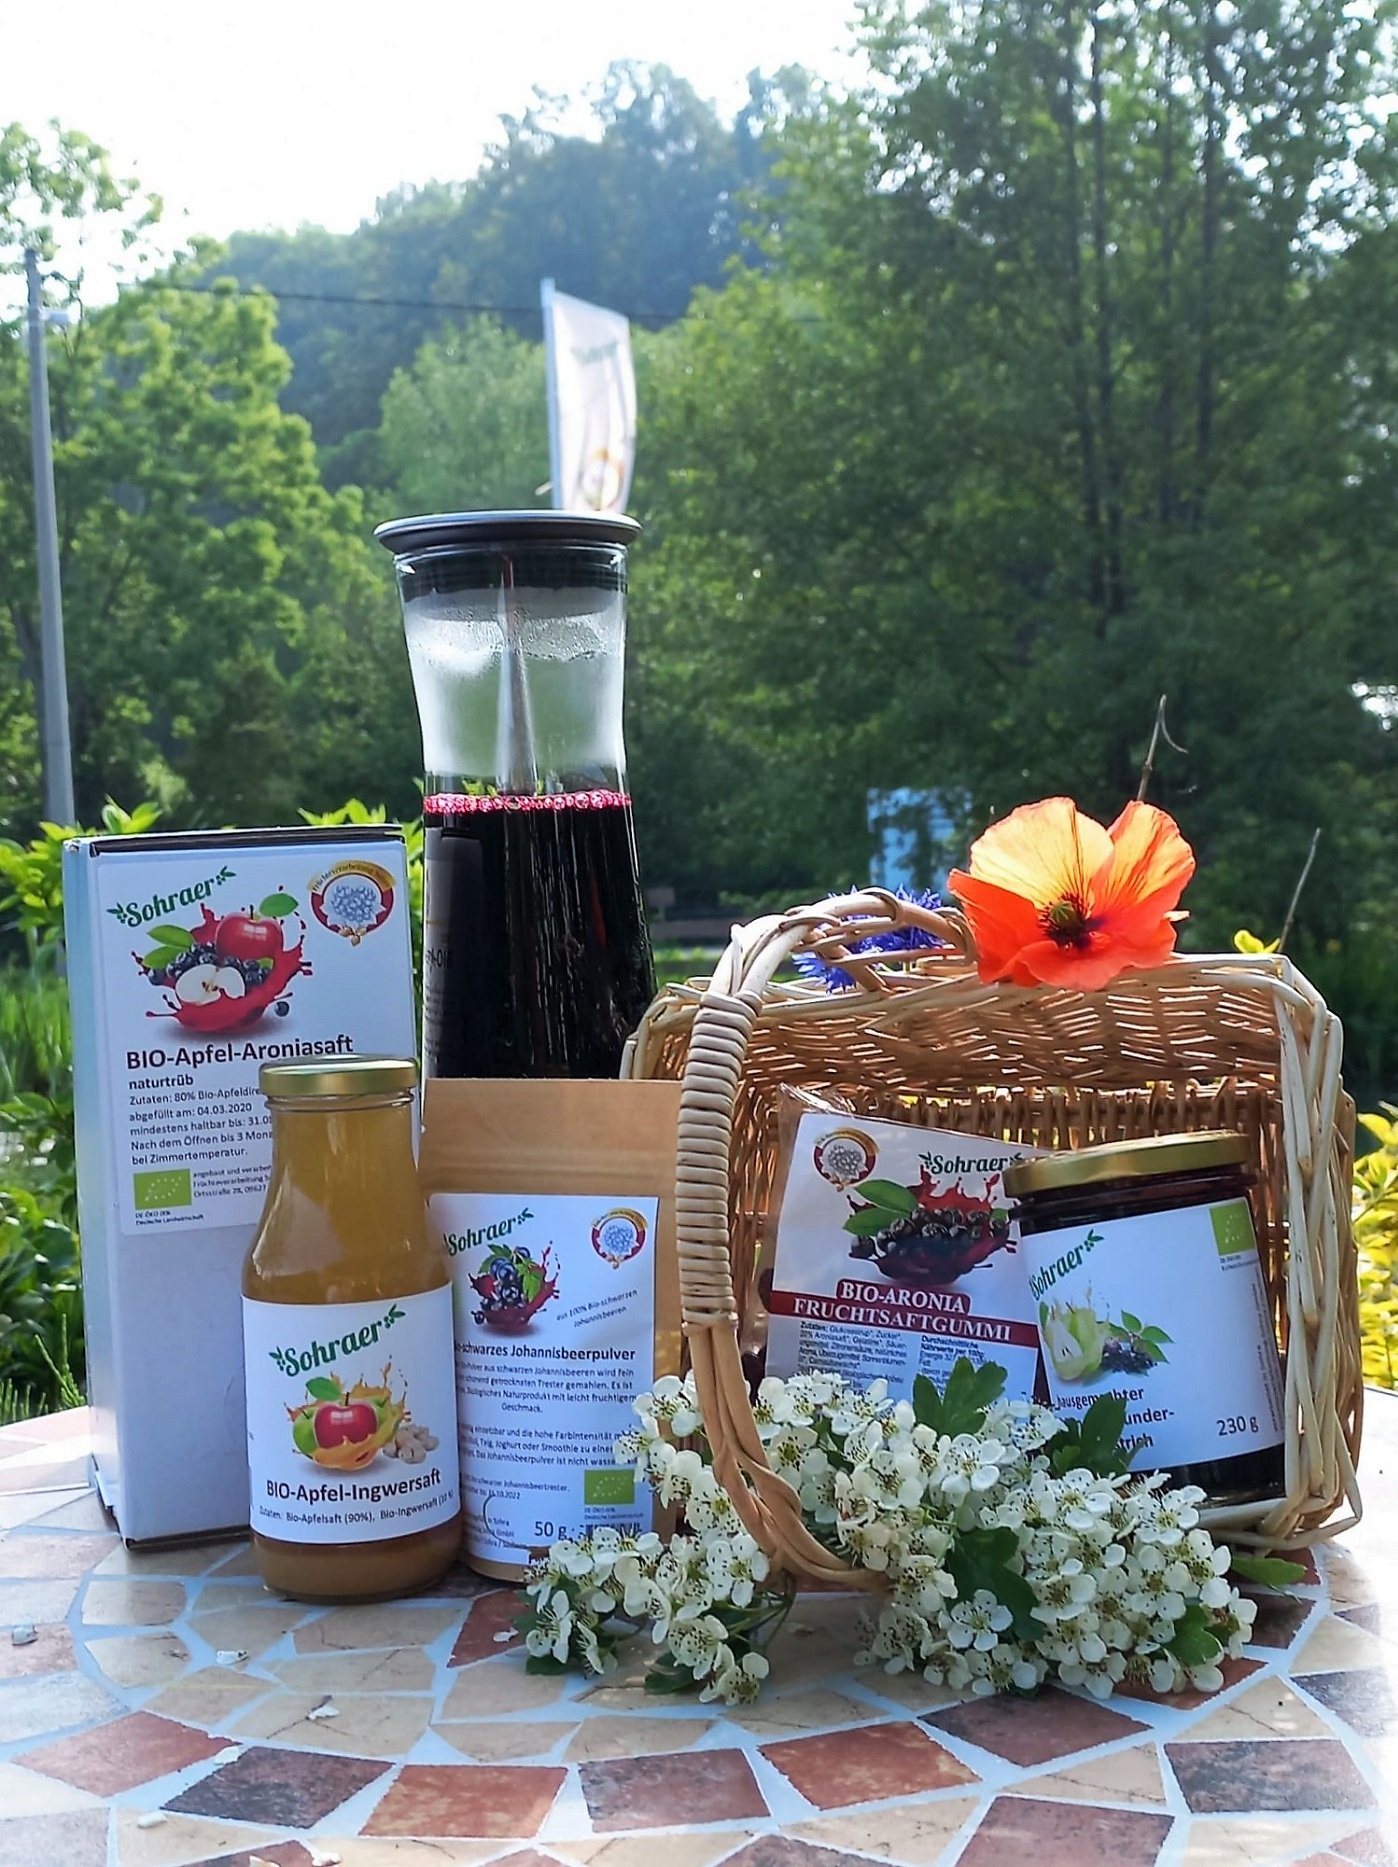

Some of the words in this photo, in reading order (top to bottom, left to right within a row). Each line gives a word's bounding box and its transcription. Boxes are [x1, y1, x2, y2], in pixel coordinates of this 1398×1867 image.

[125, 877, 216, 928] Sohraer
[127, 1034, 353, 1070] BIO-Apfel-Aroniasaft
[129, 1074, 194, 1090] naturtrüb
[130, 1093, 173, 1106] Zutaten:
[174, 1091, 196, 1102] 80%
[129, 1110, 173, 1122] abgefüllt
[176, 1109, 195, 1118] am:
[197, 1102, 252, 1116] 04.03.2020
[130, 1123, 189, 1136] mindestens
[190, 1119, 226, 1131] haltbar
[228, 1117, 245, 1128] bis:
[131, 1139, 157, 1151] Nach
[159, 1137, 182, 1148] dem
[184, 1134, 219, 1146] Öffnen
[220, 1132, 235, 1143] bis
[236, 1132, 243, 1142] 3
[132, 1153, 148, 1165] bei
[150, 1148, 248, 1163] Zimmertemperatur.
[931, 1155, 1008, 1175] Sohraer
[448, 1217, 517, 1257] Sohraer
[1032, 1243, 1084, 1301] Sohraer
[839, 1281, 966, 1314] BIO-ARONIA
[794, 1298, 1013, 1341] FRUCHTSAFTGUMMI
[284, 1319, 383, 1377] Sohraer
[510, 1343, 636, 1363] Johannisbeerpulver
[1216, 1415, 1247, 1437] 230
[1249, 1416, 1260, 1434] g
[266, 1467, 441, 1505] BIO-Apfel-Ingwersaft
[286, 1511, 342, 1525] Bio-Apfelsaft
[344, 1511, 376, 1525] (90%),
[380, 1497, 438, 1520] Bio-Ingwersaft
[534, 1520, 554, 1537] 50
[558, 1525, 567, 1541] g
